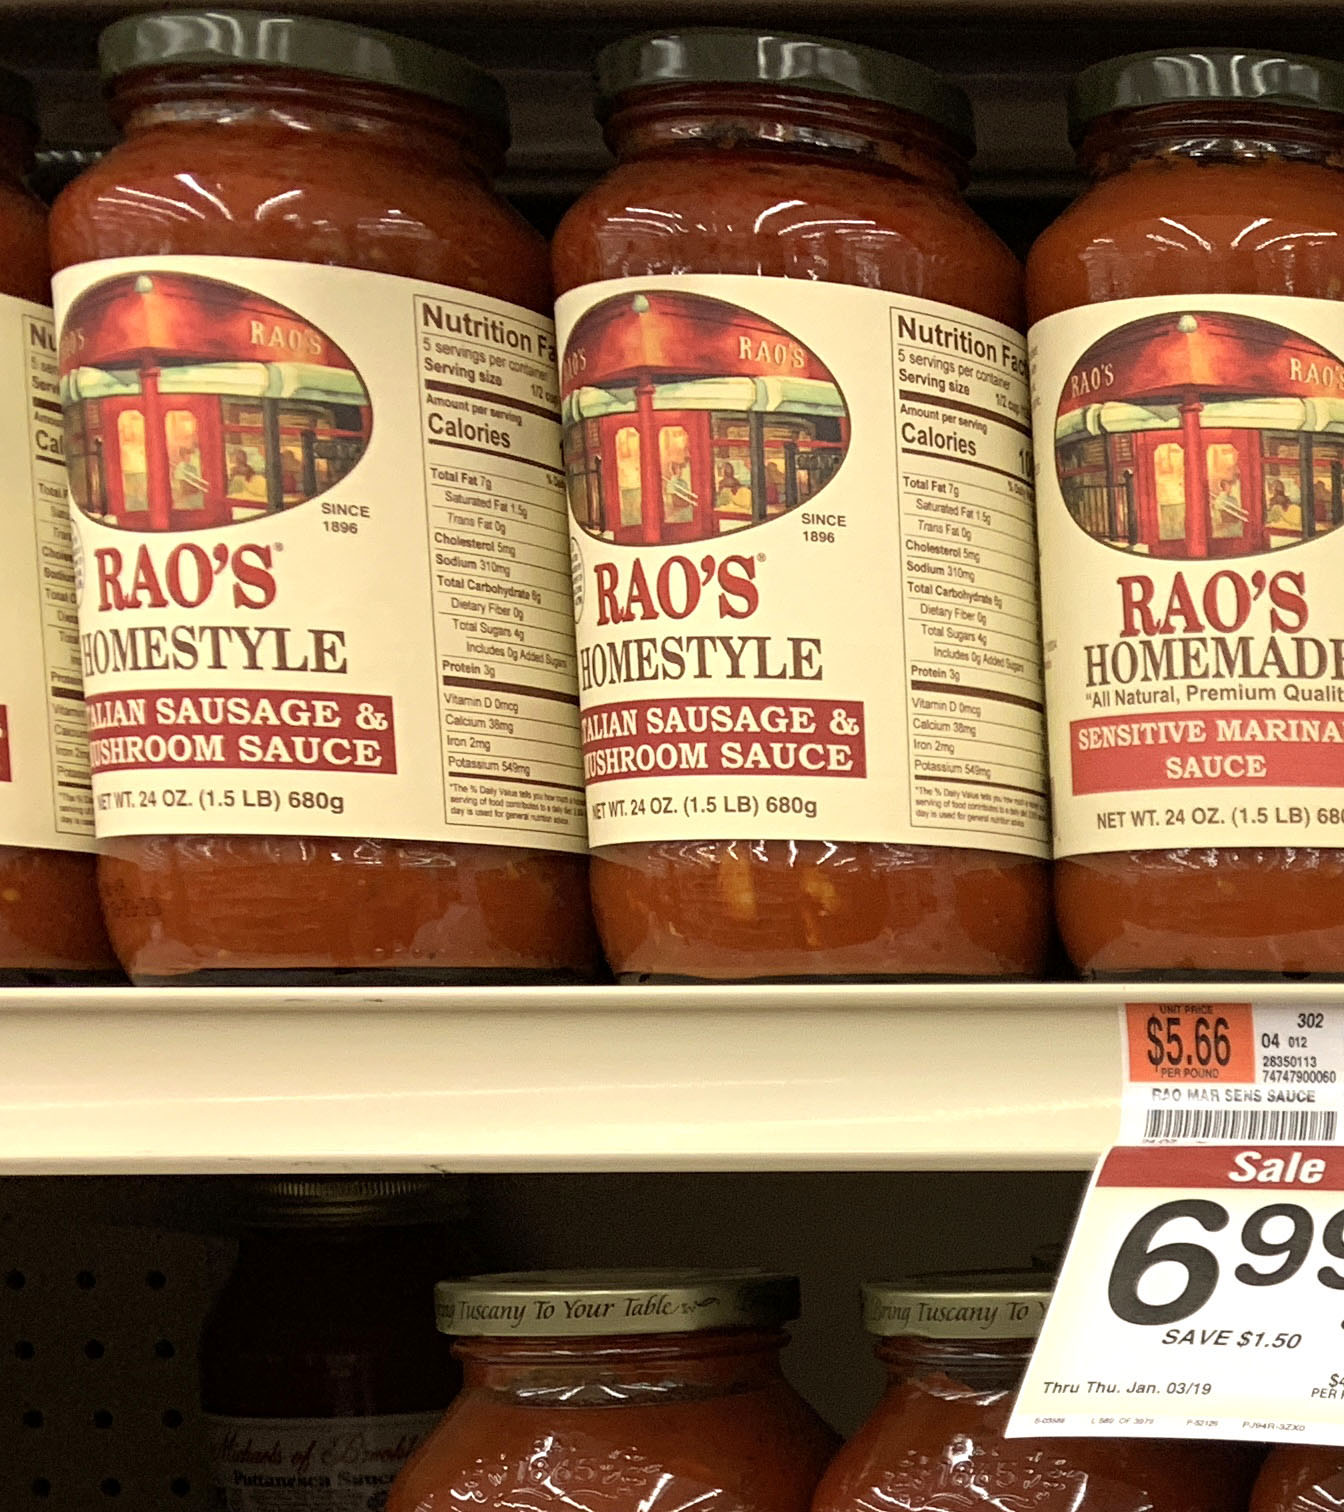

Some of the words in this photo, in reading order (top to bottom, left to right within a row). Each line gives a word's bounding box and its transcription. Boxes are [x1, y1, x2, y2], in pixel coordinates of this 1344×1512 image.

[422, 303, 532, 351] Nutrition
[901, 423, 977, 456] Calories
[94, 541, 277, 613] RAO'S
[594, 554, 759, 627] RAO'S
[1117, 570, 1310, 638] RAO'S
[82, 626, 348, 678] HOMESTYLE
[580, 636, 824, 690] HOMESTYLE
[1115, 687, 1181, 707] Natural,
[1187, 685, 1278, 701] Premium
[1078, 720, 1207, 750] SENSITIVE
[1166, 755, 1266, 779] SAUCE
[1097, 812, 1126, 829] NET
[1131, 810, 1162, 827] WT.
[1166, 810, 1186, 825] 24
[1193, 808, 1226, 826] OZ.
[1231, 808, 1269, 827] (1.5
[1274, 808, 1310, 827] LB)
[1147, 1016, 1231, 1071] $5.66
[1263, 1056, 1317, 1067] 28350113
[1229, 1151, 1325, 1184] Sale
[459, 1300, 526, 1323] Tuscany
[534, 1300, 555, 1319] To
[562, 1300, 615, 1320] Your
[622, 1297, 673, 1317] Table
[1162, 1329, 1234, 1346] SAVE
[1237, 1331, 1301, 1349] $1.50
[1043, 1381, 1080, 1394] Thru
[1086, 1381, 1121, 1394] Thu.
[1127, 1382, 1160, 1394] Jan.
[1166, 1382, 1212, 1395] 03/19
